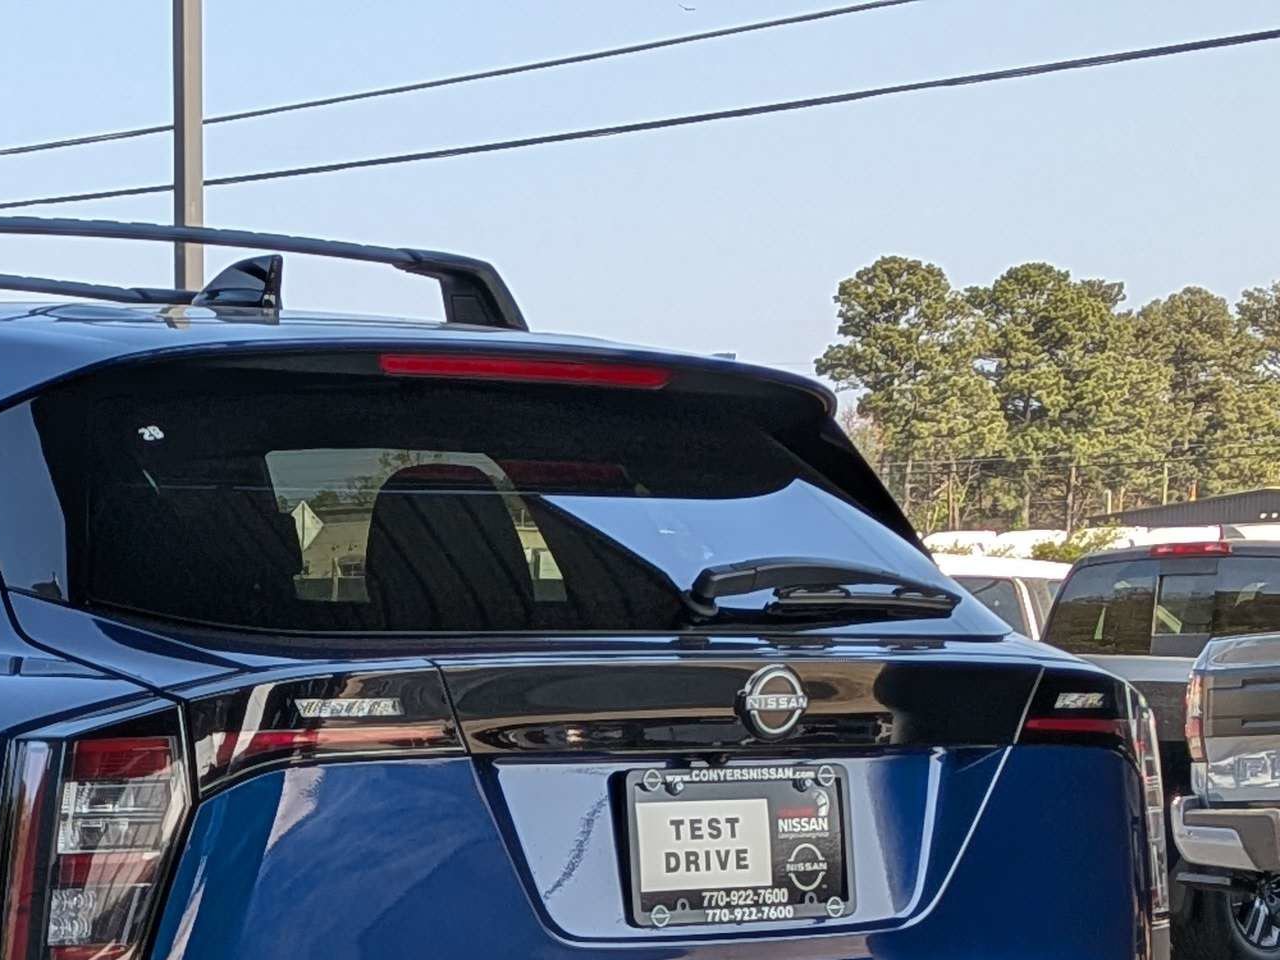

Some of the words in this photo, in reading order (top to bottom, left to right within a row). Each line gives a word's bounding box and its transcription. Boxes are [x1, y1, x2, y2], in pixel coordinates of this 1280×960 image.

[747, 694, 808, 710] NISSAN
[665, 767, 815, 782] www.CONYERSNISSAN.com
[670, 817, 741, 841] TEST
[778, 817, 829, 832] NISSAN
[664, 848, 750, 874] DRIVE
[786, 861, 828, 872] NISSAN
[702, 887, 789, 907] 770-922-7600
[705, 904, 794, 922] 770-922-7600
